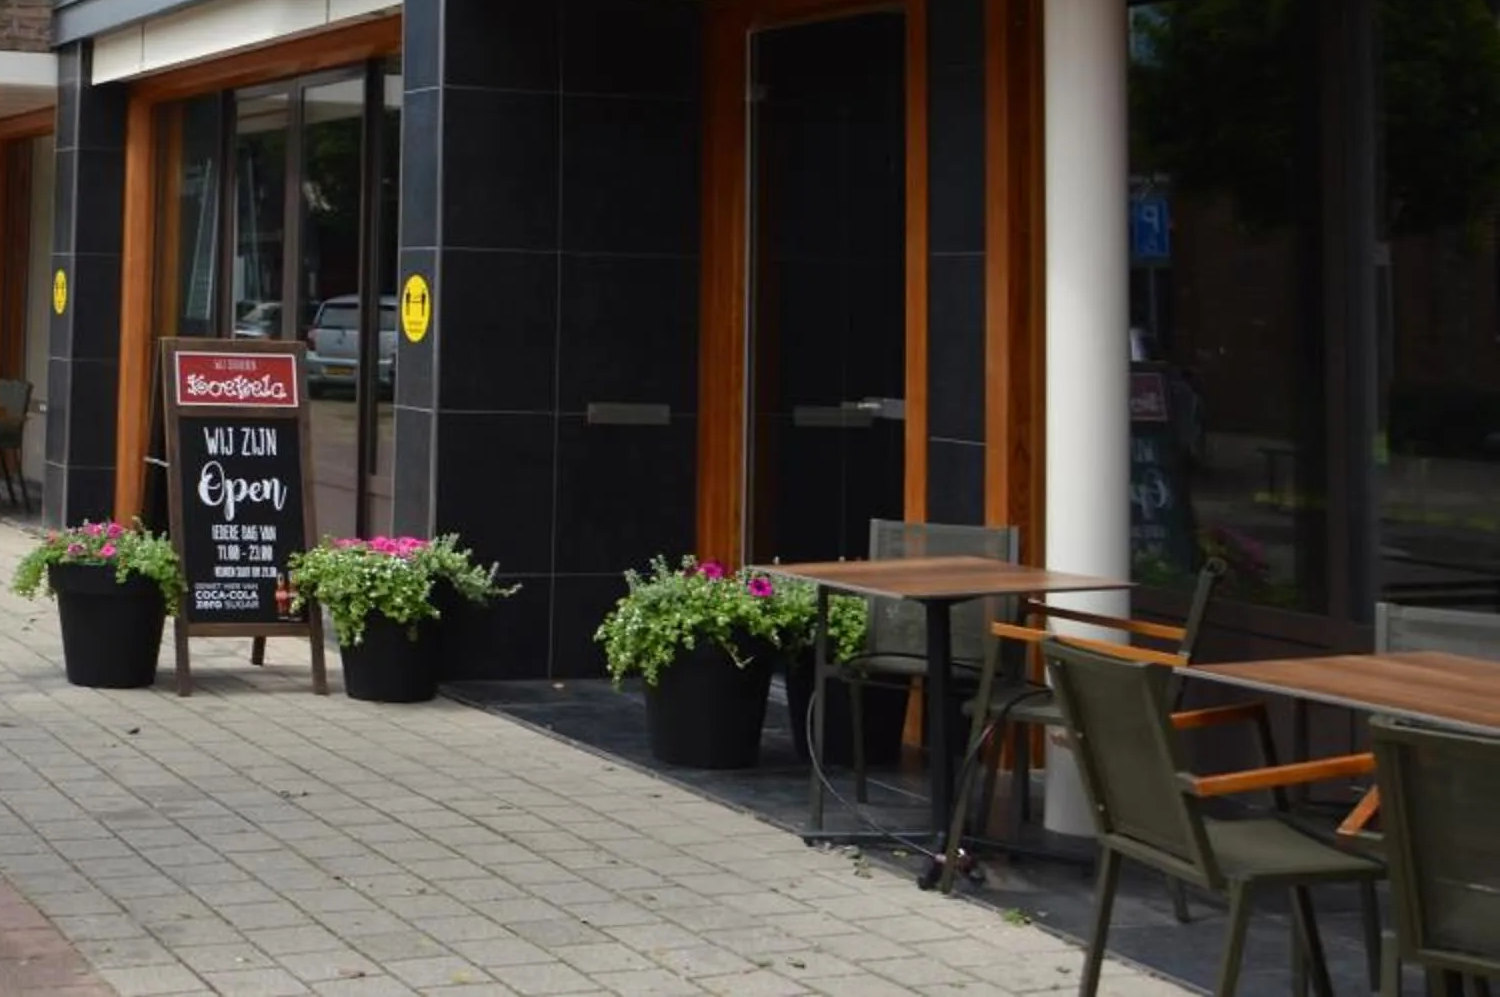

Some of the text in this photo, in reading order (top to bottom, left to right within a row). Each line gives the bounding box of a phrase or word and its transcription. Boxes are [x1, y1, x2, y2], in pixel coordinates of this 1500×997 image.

[203, 427, 277, 456] WIJ ZIJN
[198, 460, 287, 521] Open
[241, 524, 258, 541] DAG
[259, 524, 277, 542] VAN
[195, 590, 259, 600] COCA-COLA
